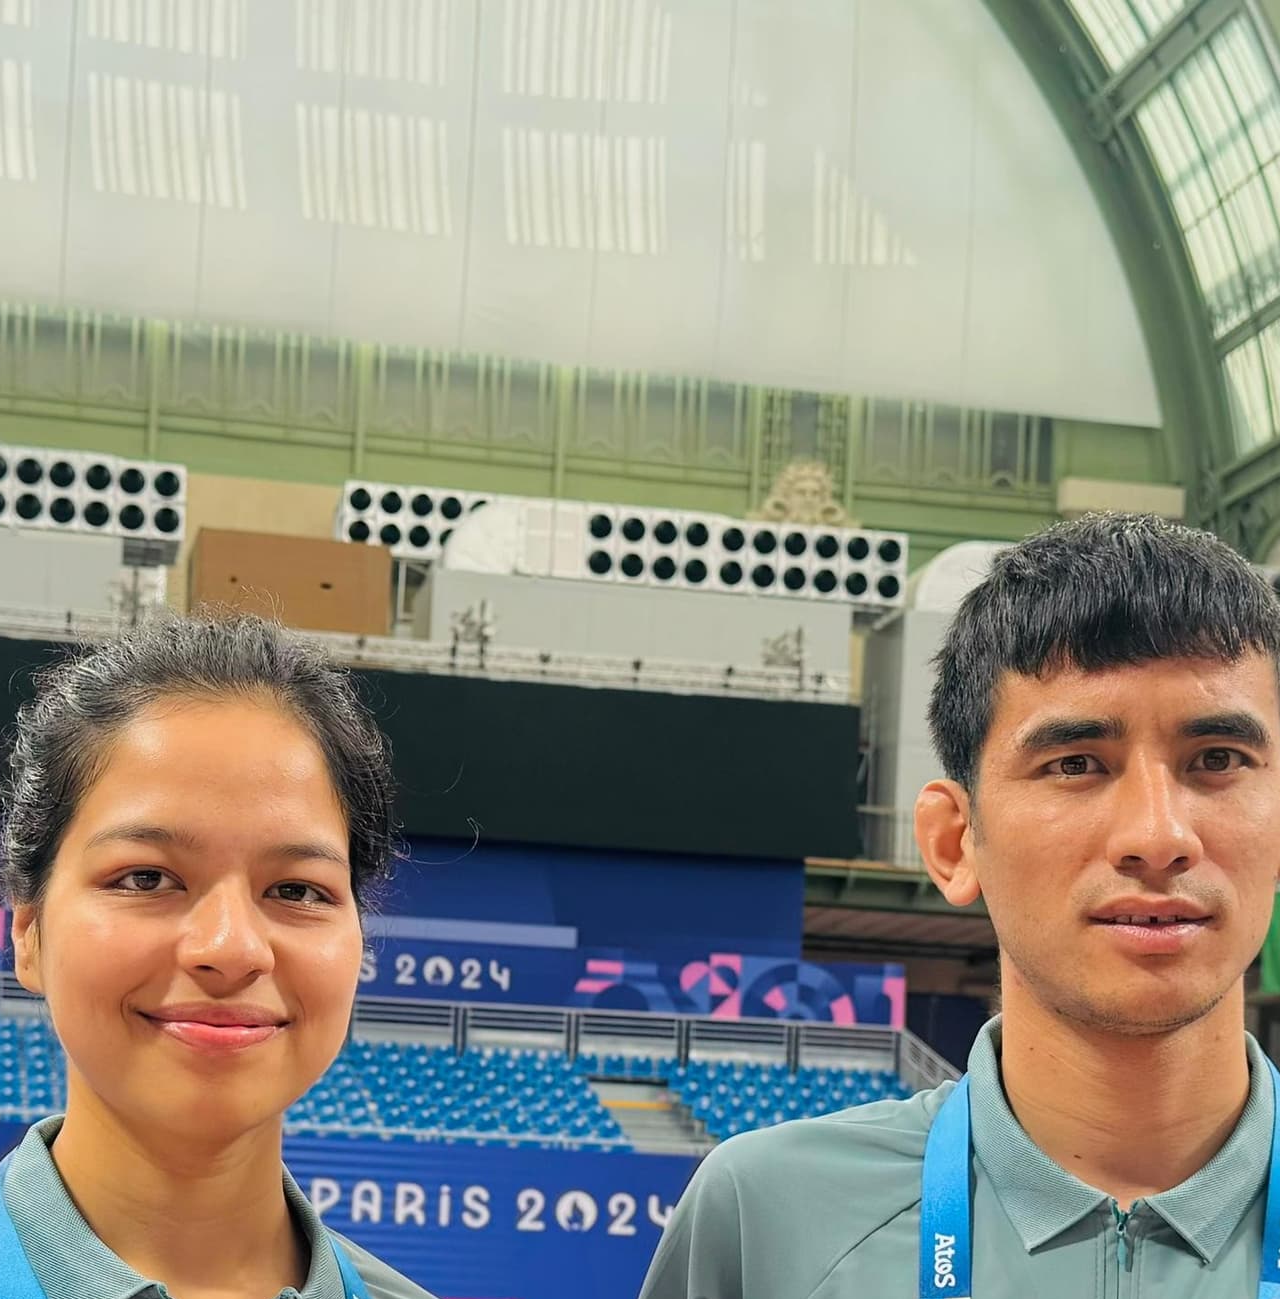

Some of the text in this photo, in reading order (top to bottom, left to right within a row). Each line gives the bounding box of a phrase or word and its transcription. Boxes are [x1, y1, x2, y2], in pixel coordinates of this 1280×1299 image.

[394, 953, 511, 992] 2024
[310, 1178, 491, 1231] PARIS
[933, 1233, 956, 1288] Atos
